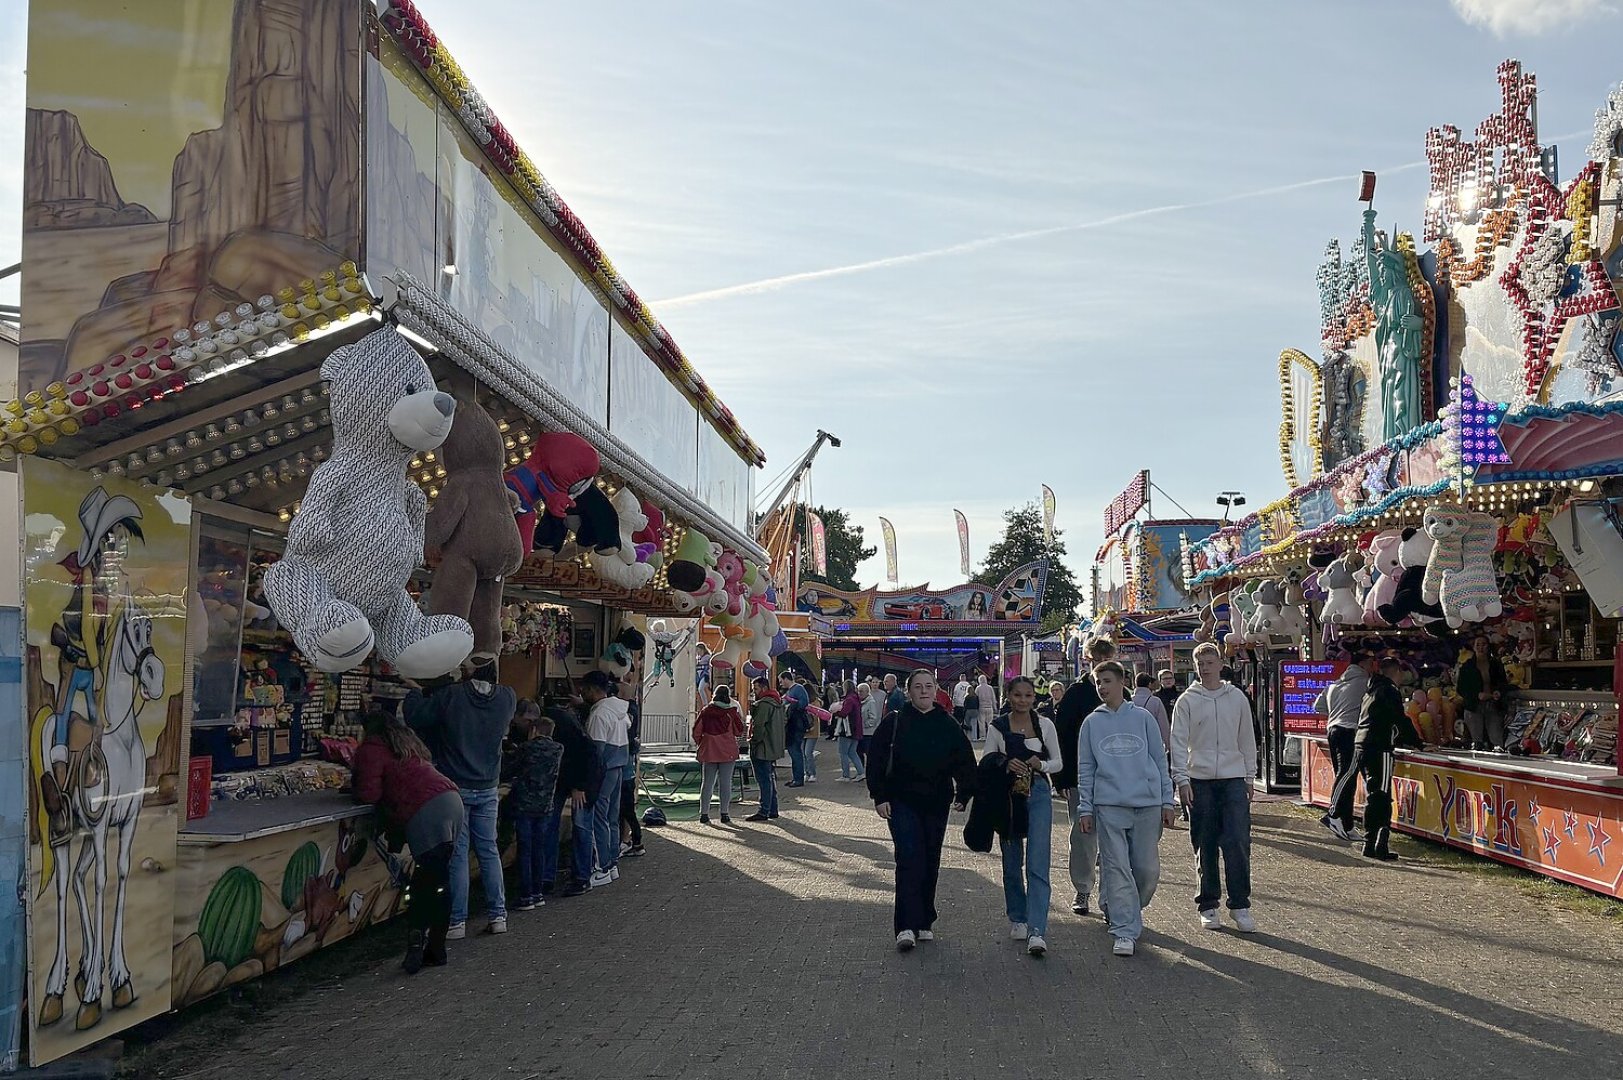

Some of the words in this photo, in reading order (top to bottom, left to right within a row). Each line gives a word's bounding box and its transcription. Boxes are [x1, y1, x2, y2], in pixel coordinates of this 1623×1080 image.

[1284, 665, 1309, 673] WER
[1284, 676, 1294, 688] 3
[1298, 678, 1335, 688] BÄLL
[1433, 773, 1522, 856] York
